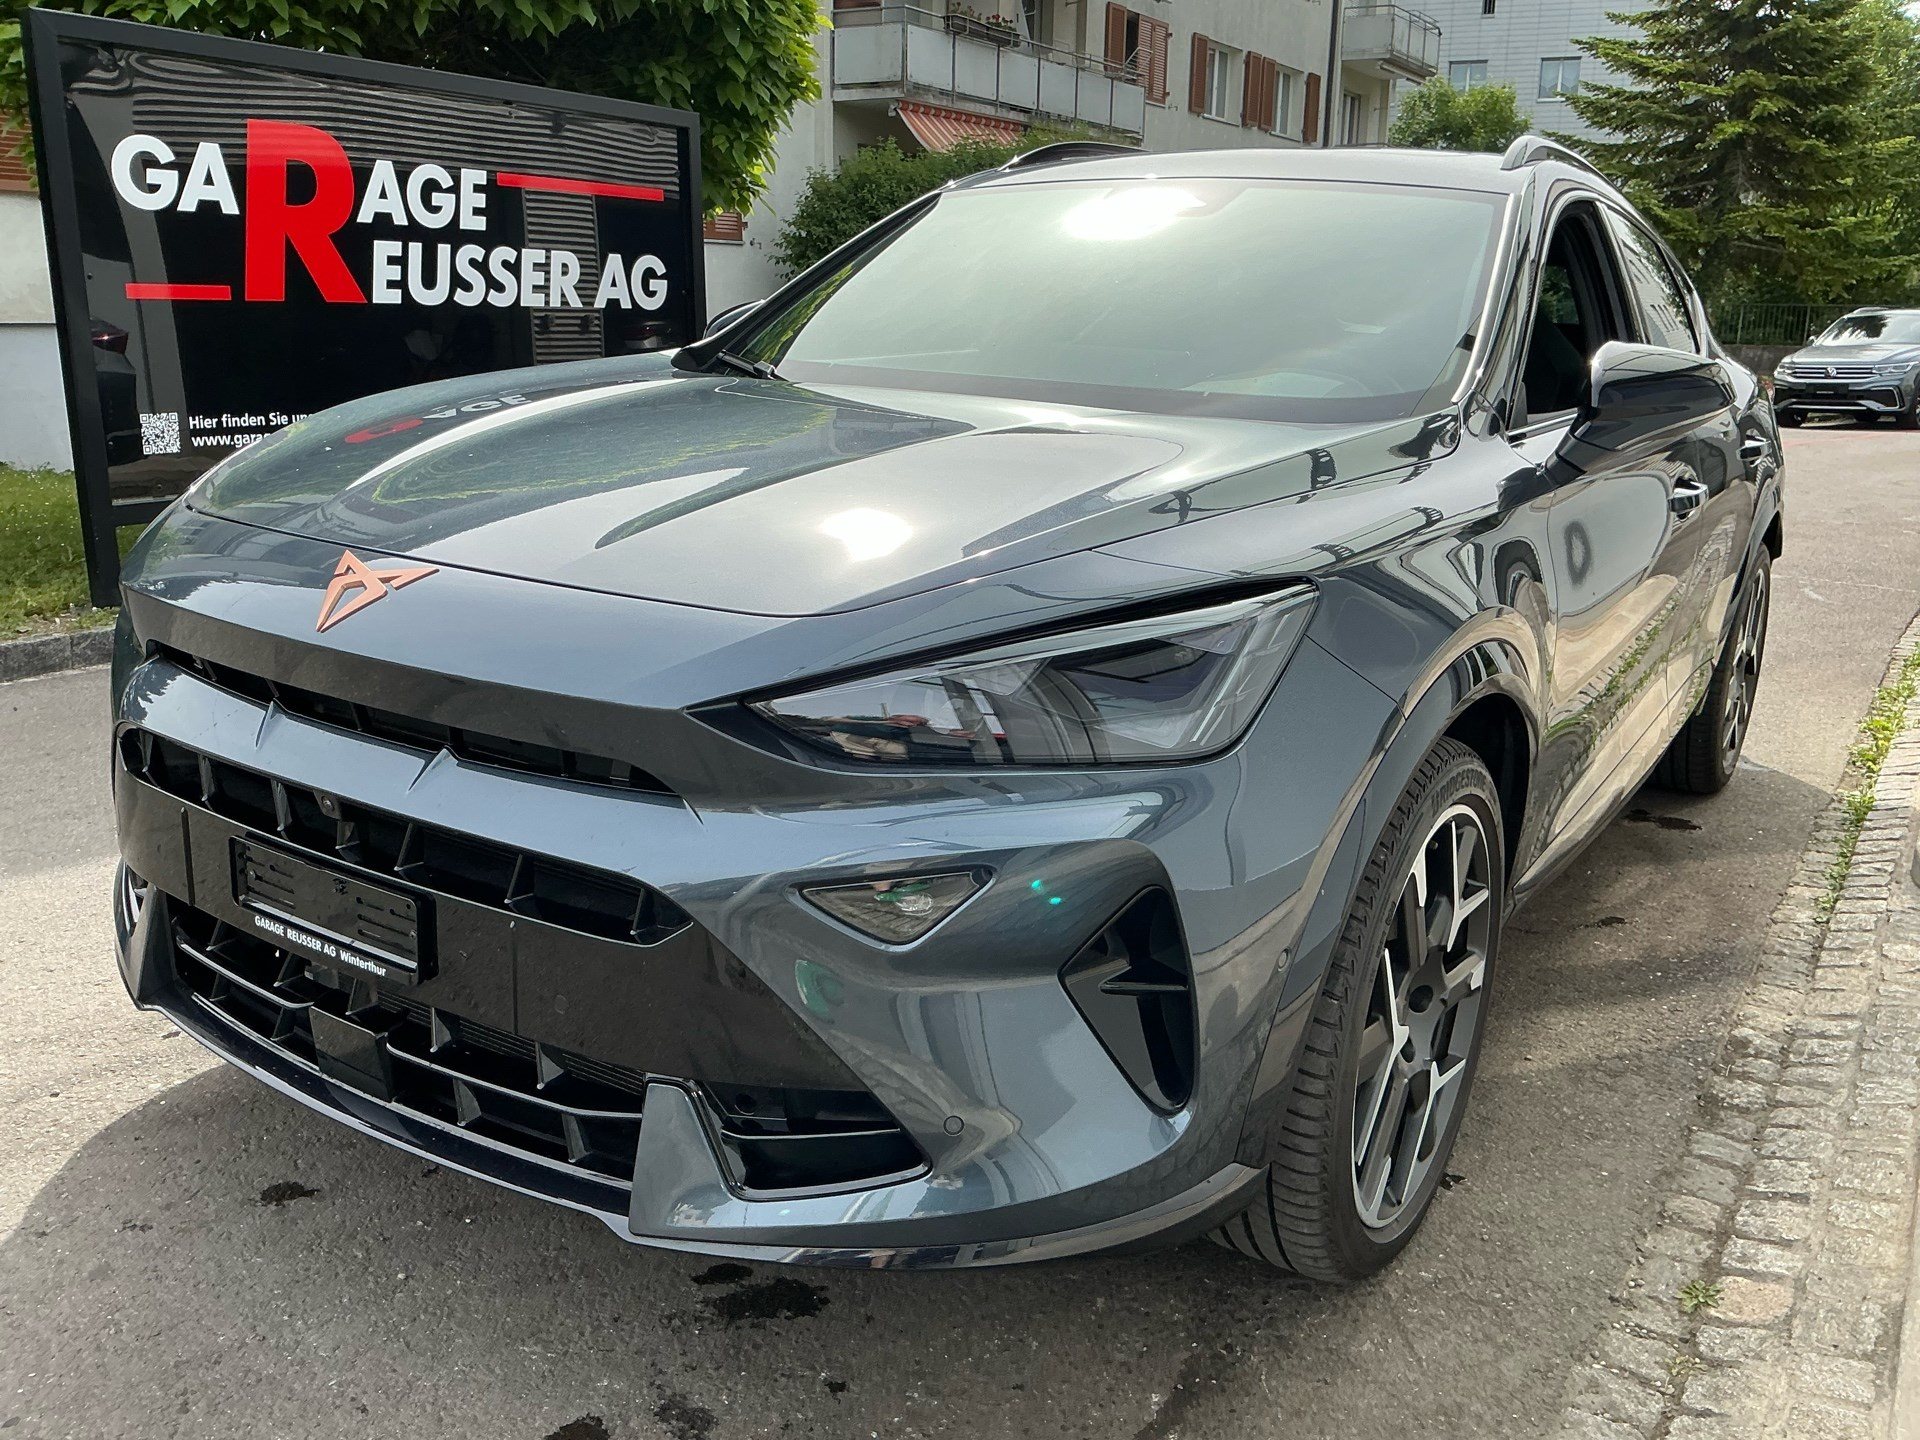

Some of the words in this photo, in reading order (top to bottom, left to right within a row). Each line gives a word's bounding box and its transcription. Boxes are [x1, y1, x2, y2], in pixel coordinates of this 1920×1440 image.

[111, 120, 487, 303] GARAGE
[594, 253, 668, 311] AG
[189, 414, 219, 429] Hier
[221, 412, 266, 428] finden
[269, 411, 289, 426] Sie
[254, 915, 285, 937] GARAGE
[286, 928, 322, 953] REUSSER
[323, 943, 337, 957] AG
[340, 949, 387, 977] Winterthur
